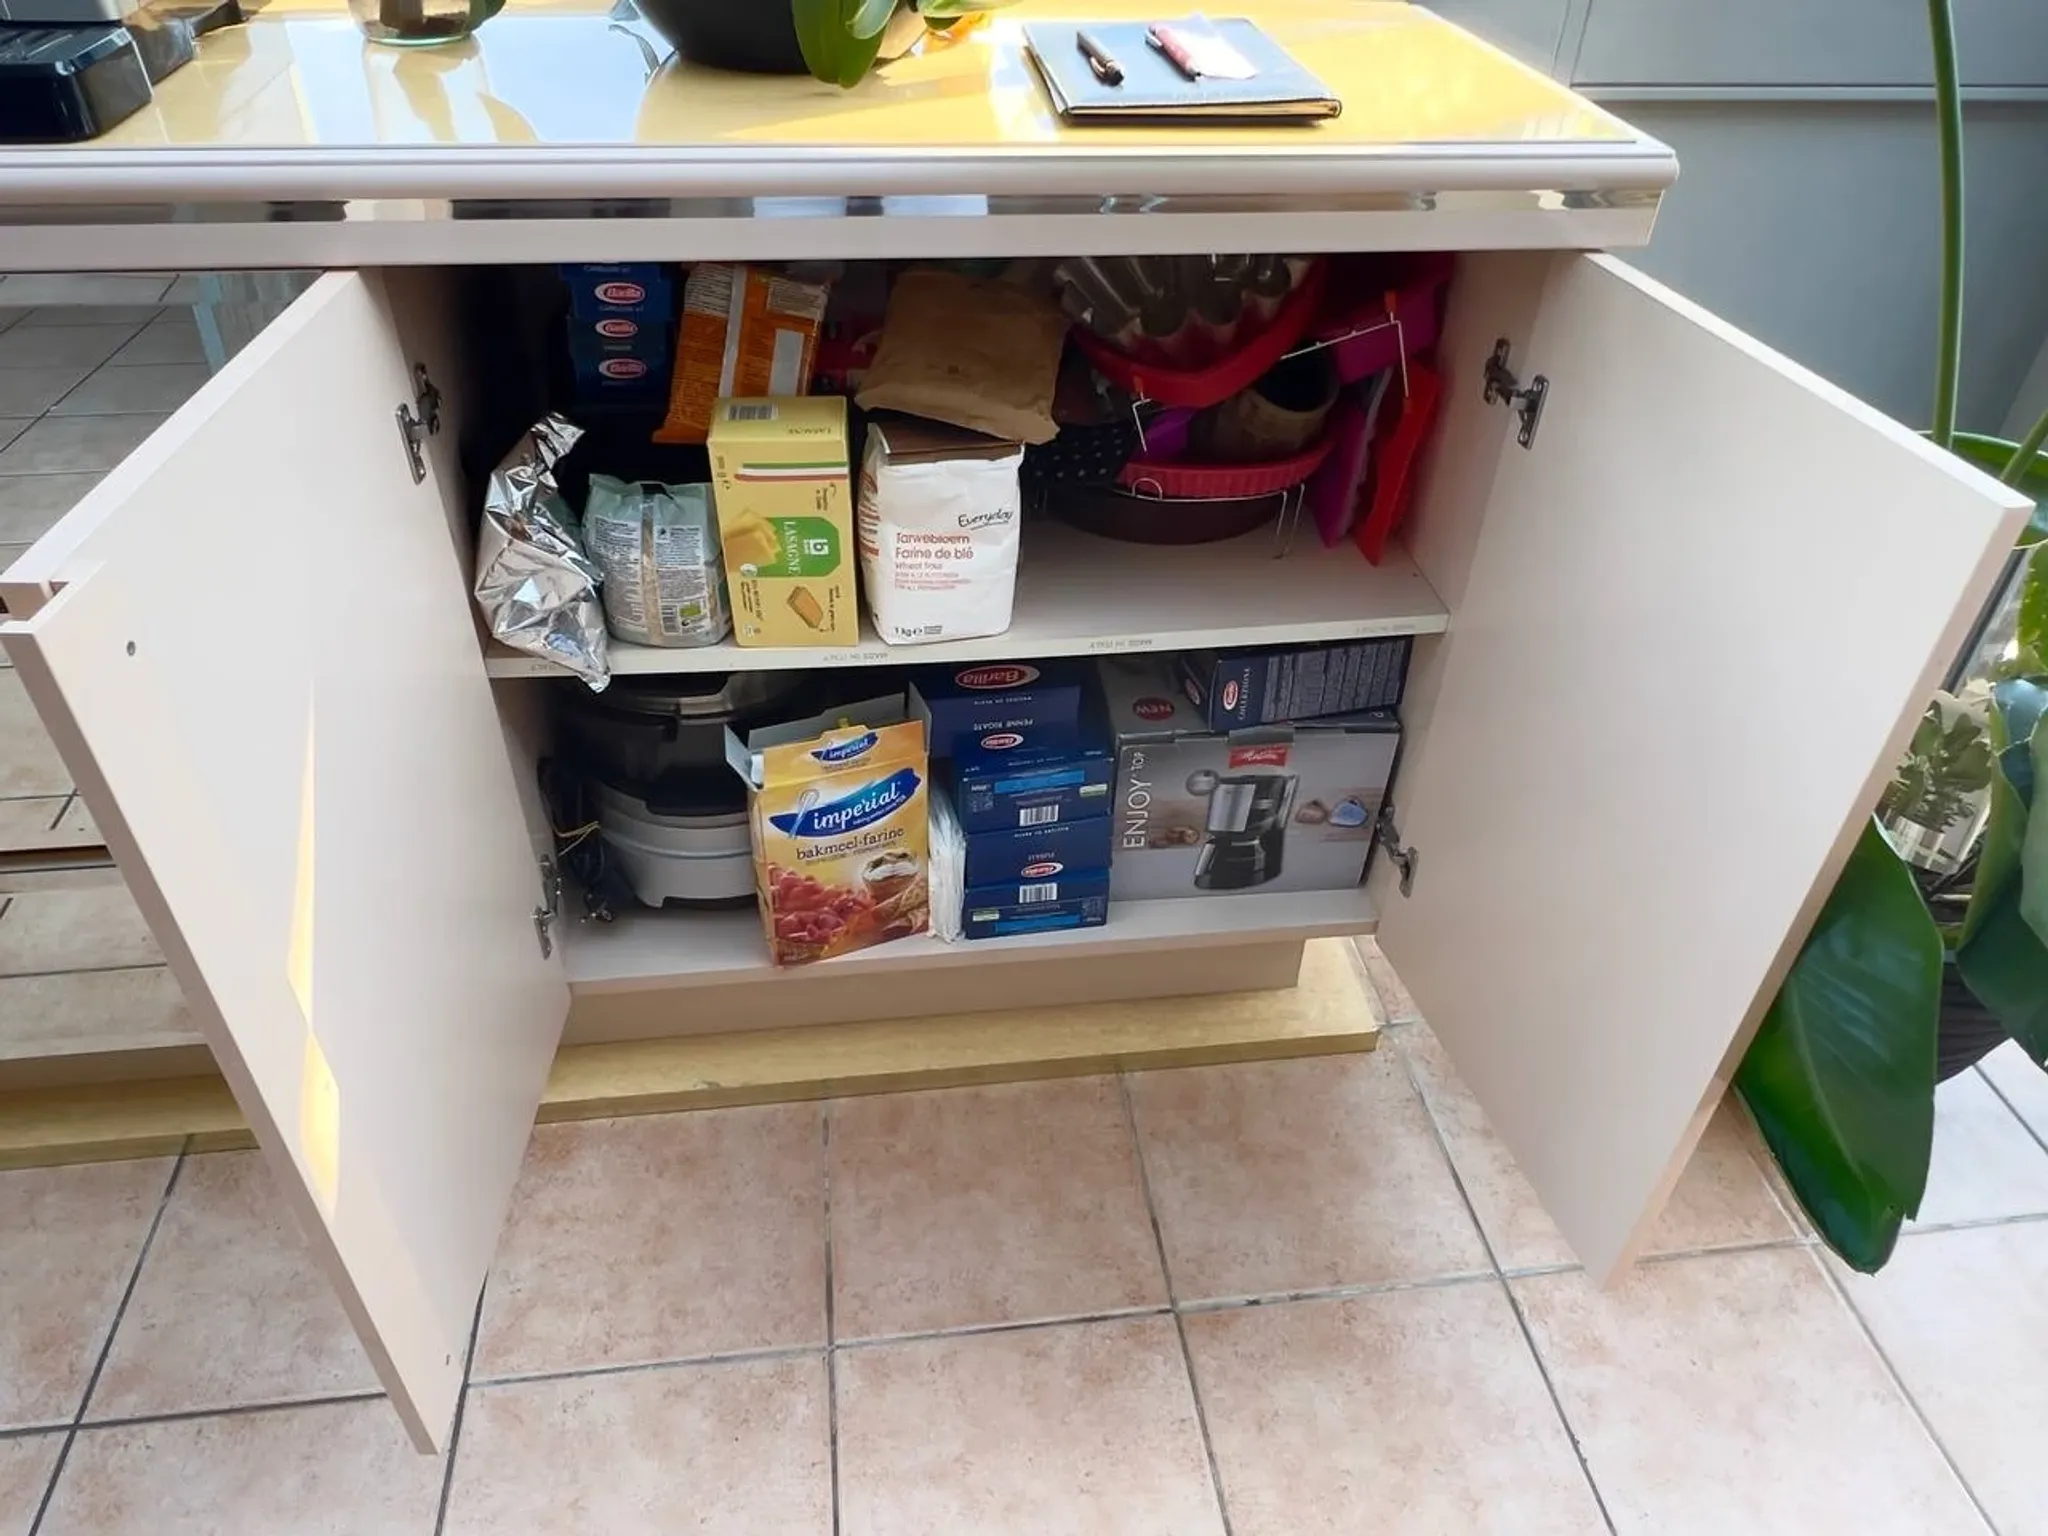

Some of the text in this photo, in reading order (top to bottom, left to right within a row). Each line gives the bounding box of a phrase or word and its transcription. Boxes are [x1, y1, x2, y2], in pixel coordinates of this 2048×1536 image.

[957, 508, 1013, 530] Everyday
[783, 521, 800, 576] LASAGNE
[895, 532, 971, 544] Tarwebloem
[895, 546, 975, 560] Farine de blé
[901, 626, 912, 637] kg
[962, 670, 1020, 685] Barilla
[829, 737, 870, 759] imperial
[813, 780, 902, 830] imperial
[1123, 778, 1152, 848] ENJOY
